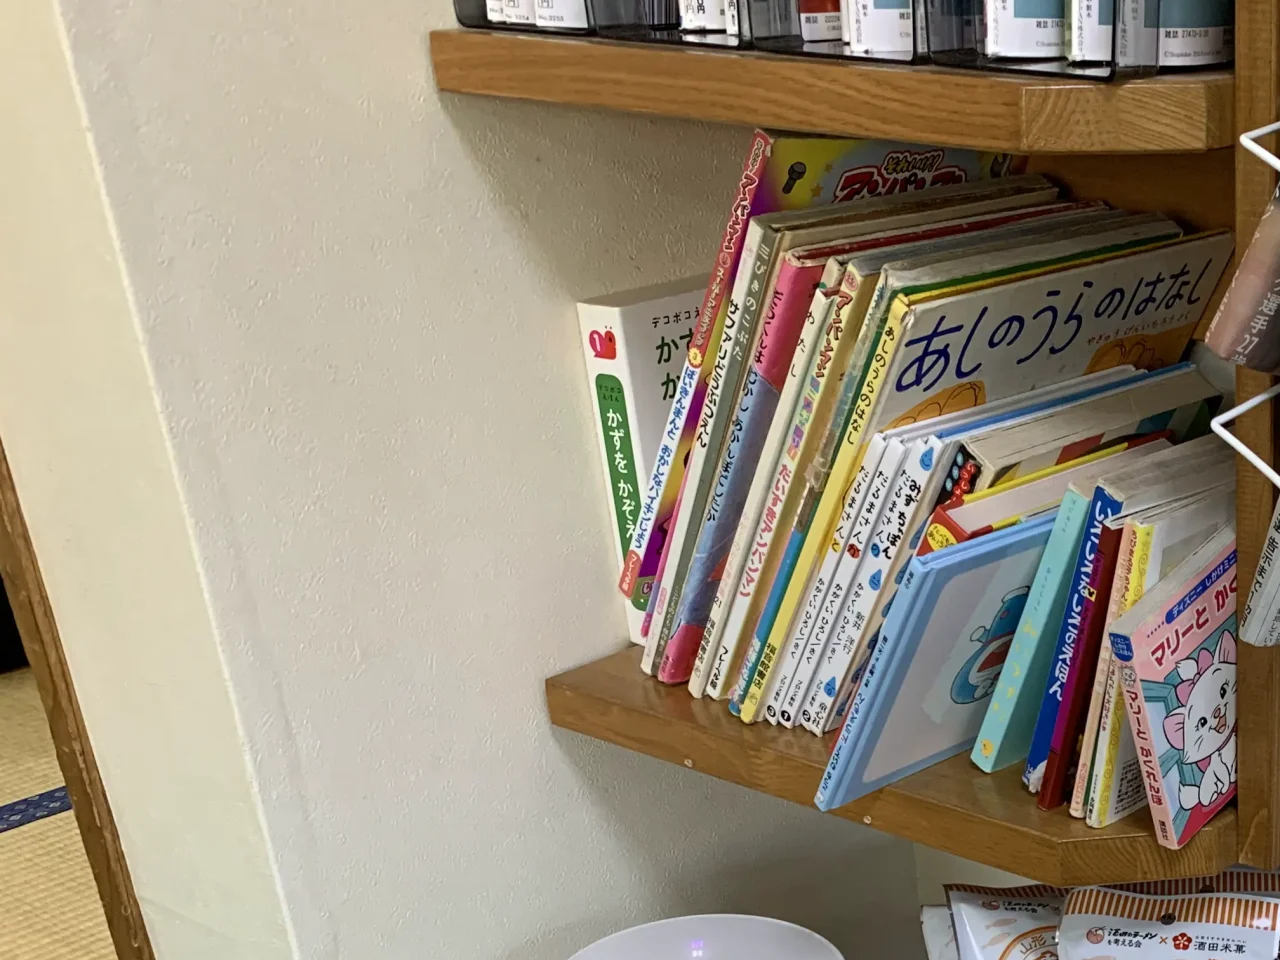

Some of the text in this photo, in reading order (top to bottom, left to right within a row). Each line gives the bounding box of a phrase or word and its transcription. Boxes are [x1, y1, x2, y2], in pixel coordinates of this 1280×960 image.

[732, 243, 770, 362] 三びきのこぶた
[895, 257, 1214, 393] あしのうらのはなし
[846, 326, 896, 445] あしのうらのはなし
[606, 409, 629, 474] かずを
[1171, 586, 1203, 617] ディズニー
[1150, 603, 1210, 669] マリーと
[1125, 689, 1163, 807] マリーと かくれんぼ
[1106, 938, 1143, 949] を考える会
[1193, 940, 1247, 955] 酒田米菓
